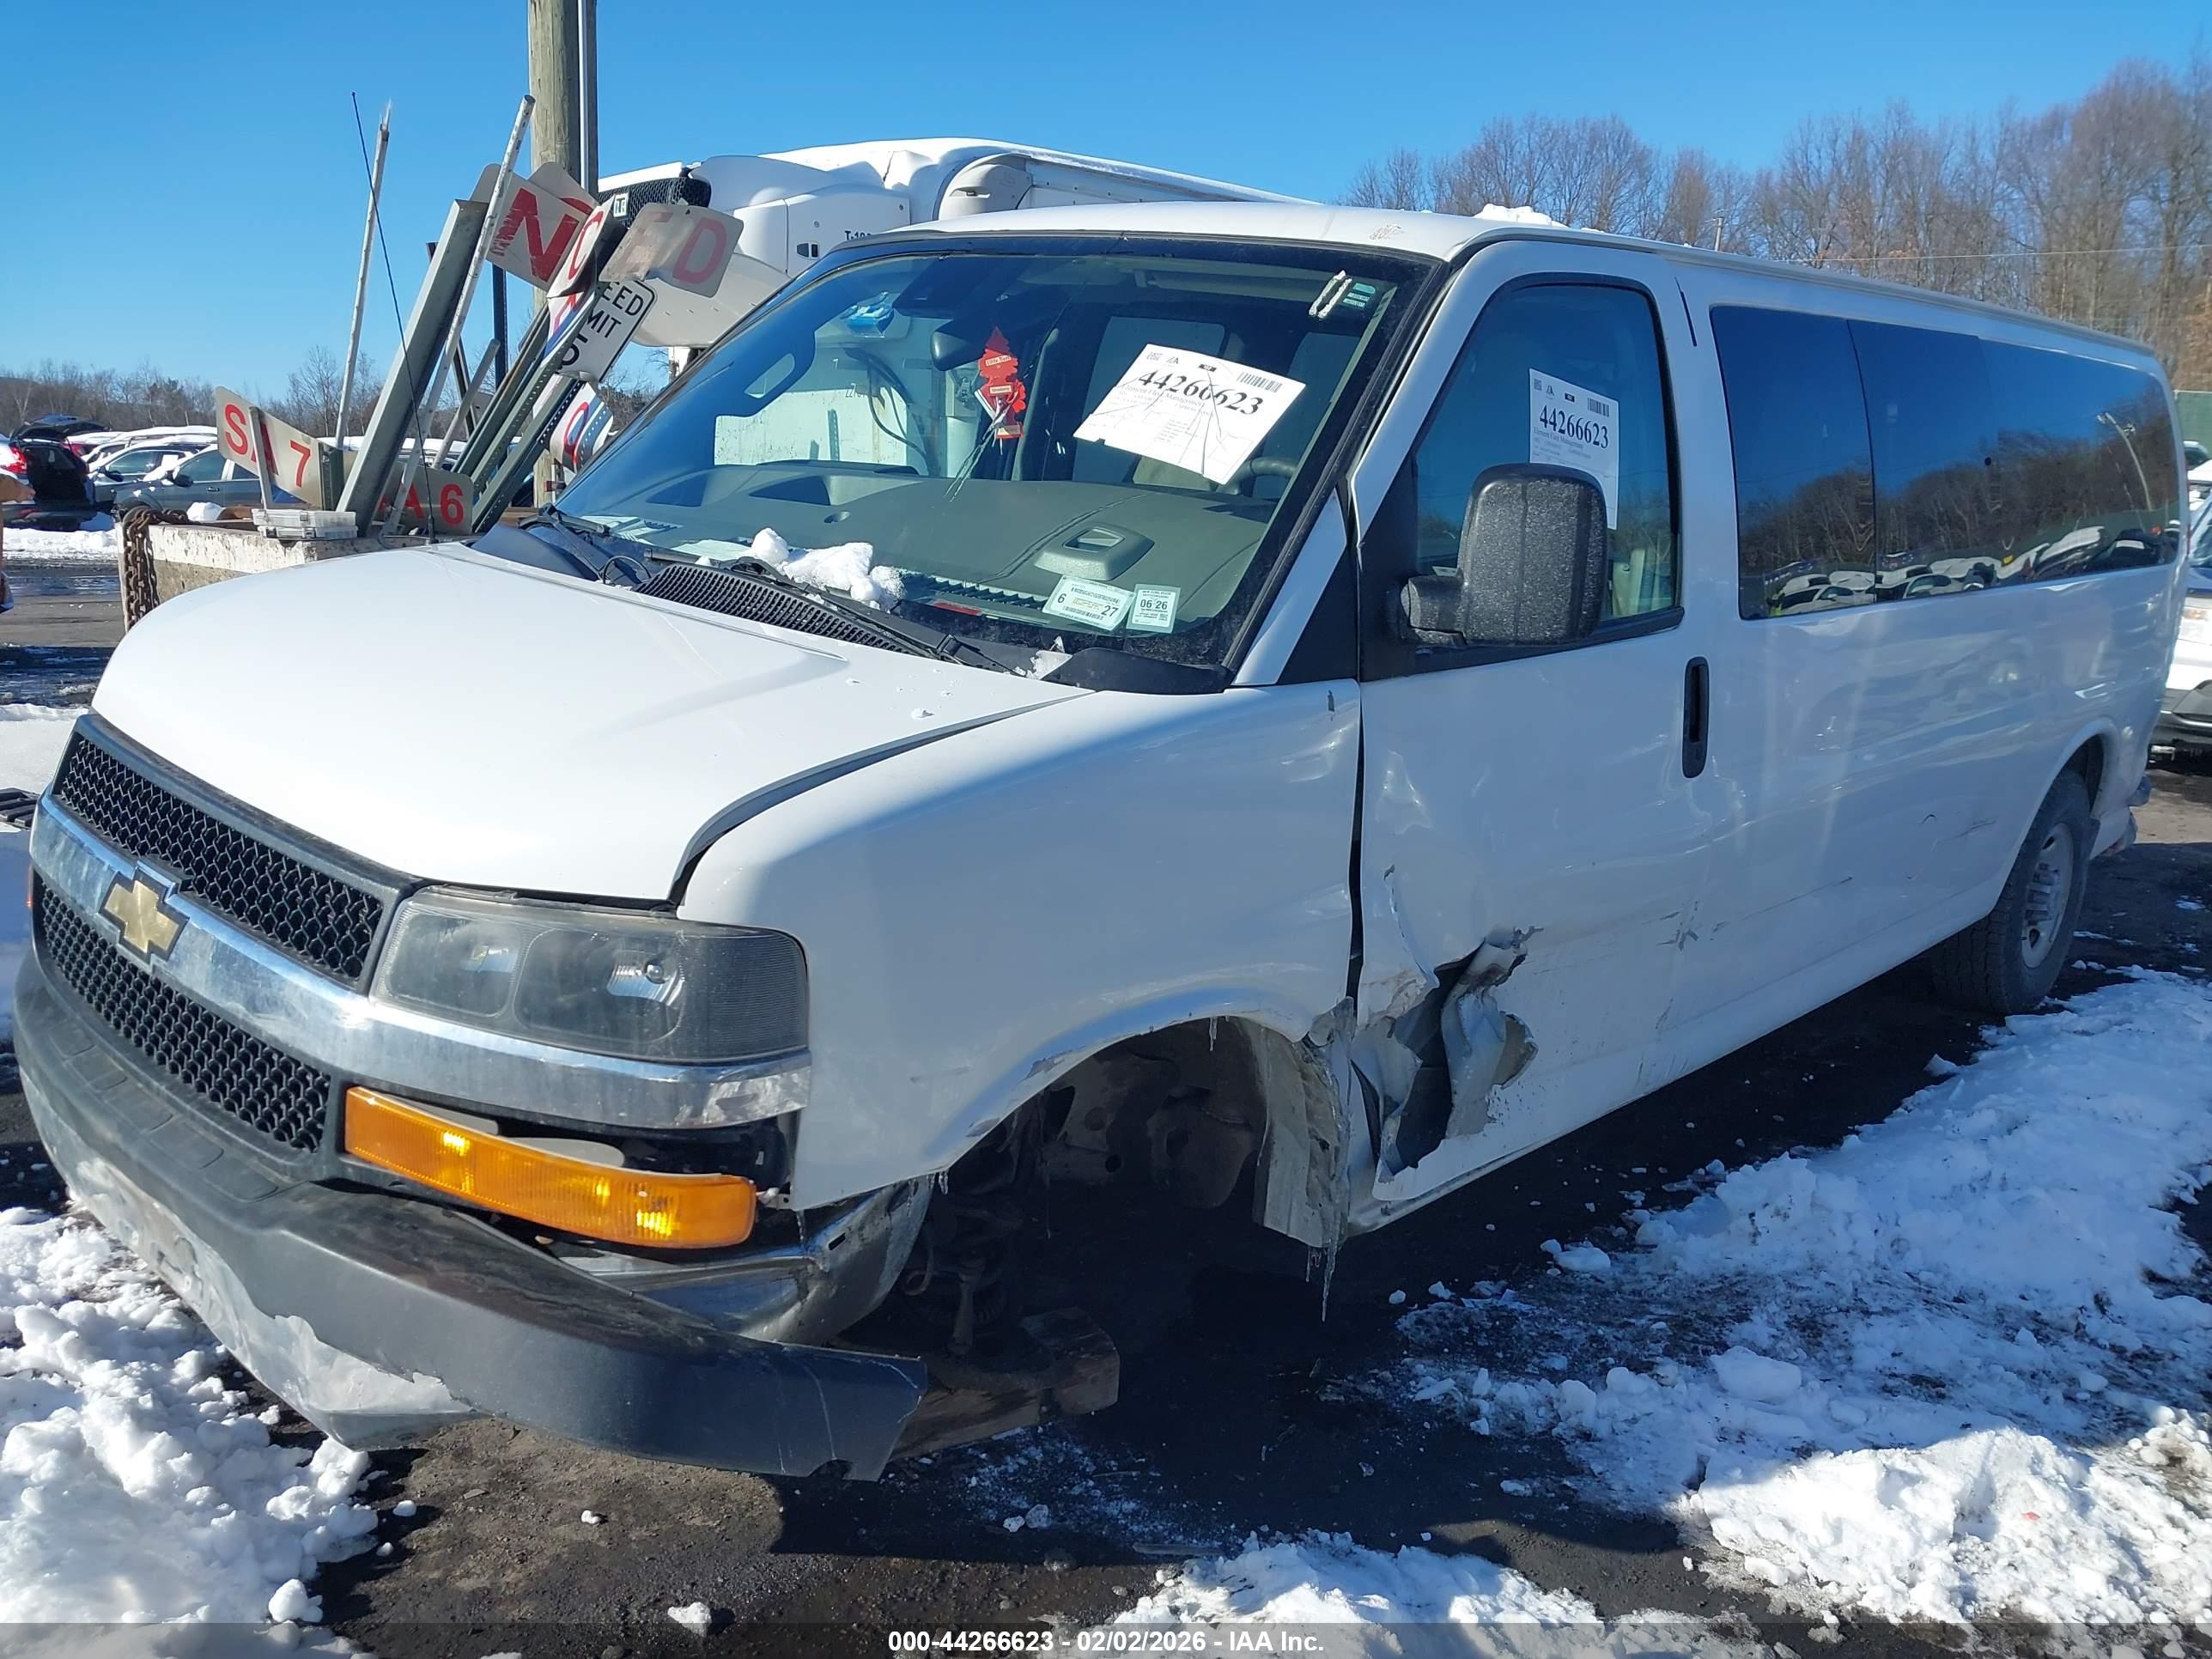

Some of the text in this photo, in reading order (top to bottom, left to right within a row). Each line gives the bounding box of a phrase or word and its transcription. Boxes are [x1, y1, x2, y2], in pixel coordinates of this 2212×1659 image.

[1138, 369, 1263, 415] 44266623
[1540, 404, 1609, 449] 44266623
[289, 439, 311, 488] 7
[441, 483, 464, 525] 6
[1057, 592, 1067, 604] 6
[1101, 605, 1119, 617] 27
